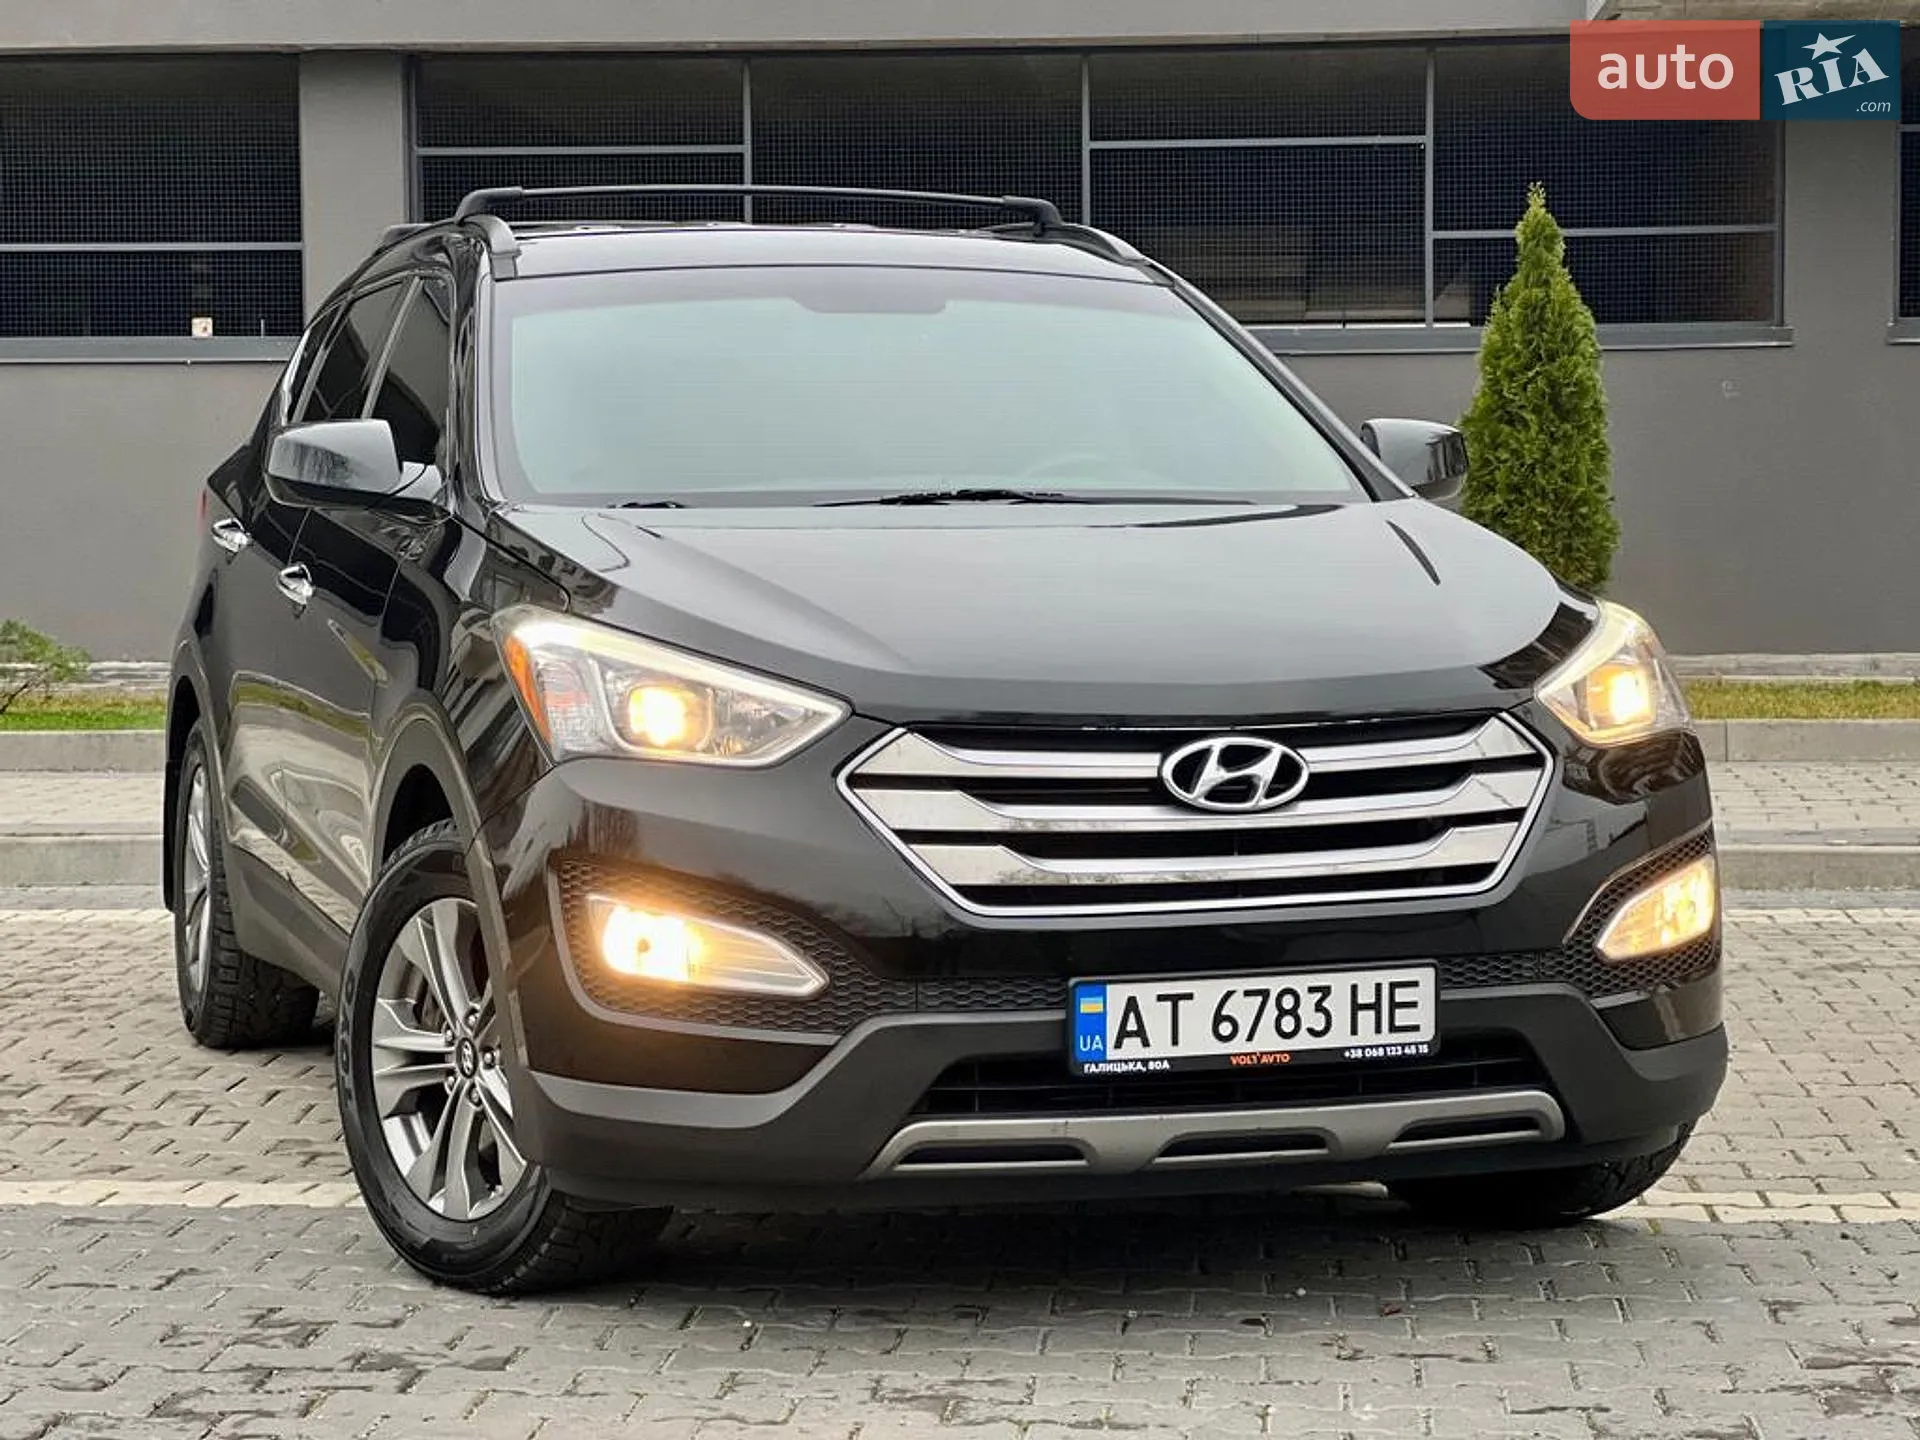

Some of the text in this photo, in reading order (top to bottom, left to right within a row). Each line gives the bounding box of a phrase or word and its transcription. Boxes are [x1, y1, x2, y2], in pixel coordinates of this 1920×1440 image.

[1113, 980, 1421, 1050] AT 6783 HE
[1080, 1036, 1103, 1051] UA
